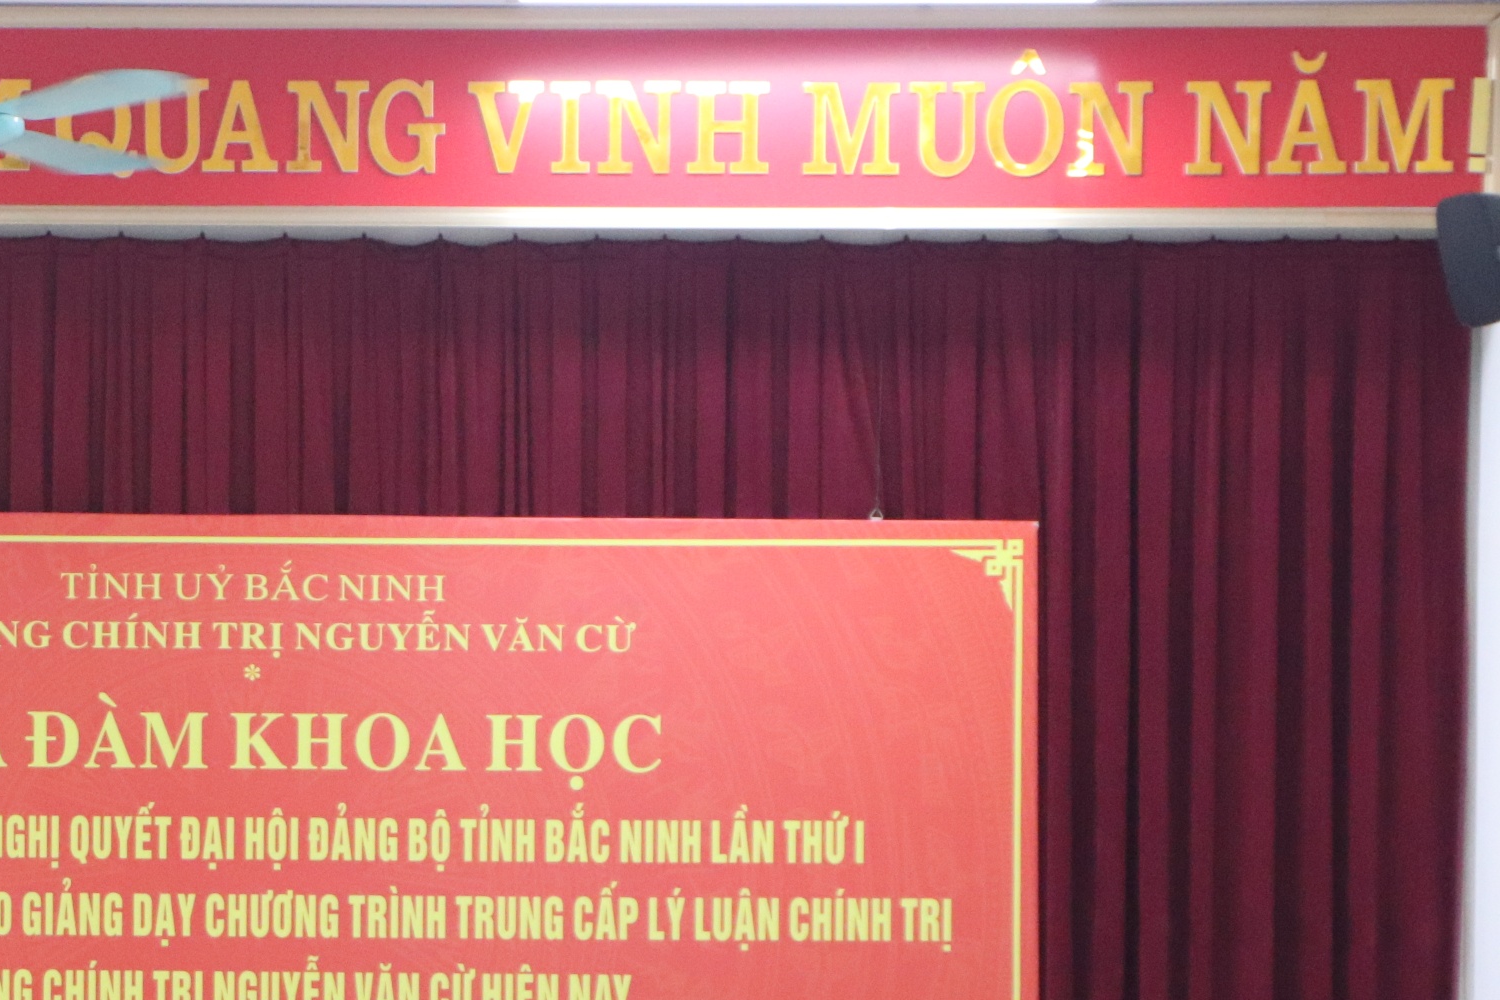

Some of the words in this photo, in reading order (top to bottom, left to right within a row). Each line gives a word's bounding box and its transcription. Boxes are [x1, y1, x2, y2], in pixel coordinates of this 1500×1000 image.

[468, 80, 770, 175] VINH
[802, 49, 1155, 178] MUÔN
[60, 563, 163, 601] TỈNH
[173, 563, 234, 601] UỶ
[243, 559, 329, 603] BẮC
[338, 573, 447, 603] NINH
[62, 612, 202, 650] CHÍNH
[212, 621, 284, 659] TRỊ
[295, 609, 472, 652] NGUYỄN
[480, 616, 566, 653] VĂN
[574, 615, 638, 654] CỪ
[24, 691, 209, 769] ĐÀM
[229, 712, 467, 772] KHOA
[485, 713, 662, 791] HỌC
[69, 801, 172, 865] QUYẾT
[179, 815, 235, 871] ĐẠI
[244, 807, 299, 871] HỘI
[307, 802, 399, 863] ĐẢNG
[407, 808, 451, 873] BỘ
[459, 803, 536, 863] TỈNH
[544, 801, 611, 864] BẮC
[619, 819, 702, 864] NINH
[710, 803, 775, 864] LẦN
[782, 810, 850, 865] THỨ
[22, 877, 123, 937] GIẢNG
[132, 892, 196, 947] DẠY
[205, 889, 339, 939] CHƯƠNG
[347, 885, 447, 940] TRÌNH
[454, 895, 564, 941] TRUNG
[573, 880, 639, 941] CẤP
[647, 887, 686, 941] LÝ
[693, 887, 780, 952] LUẬN
[788, 888, 892, 942] CHÍNH
[899, 897, 953, 953] TRỊ
